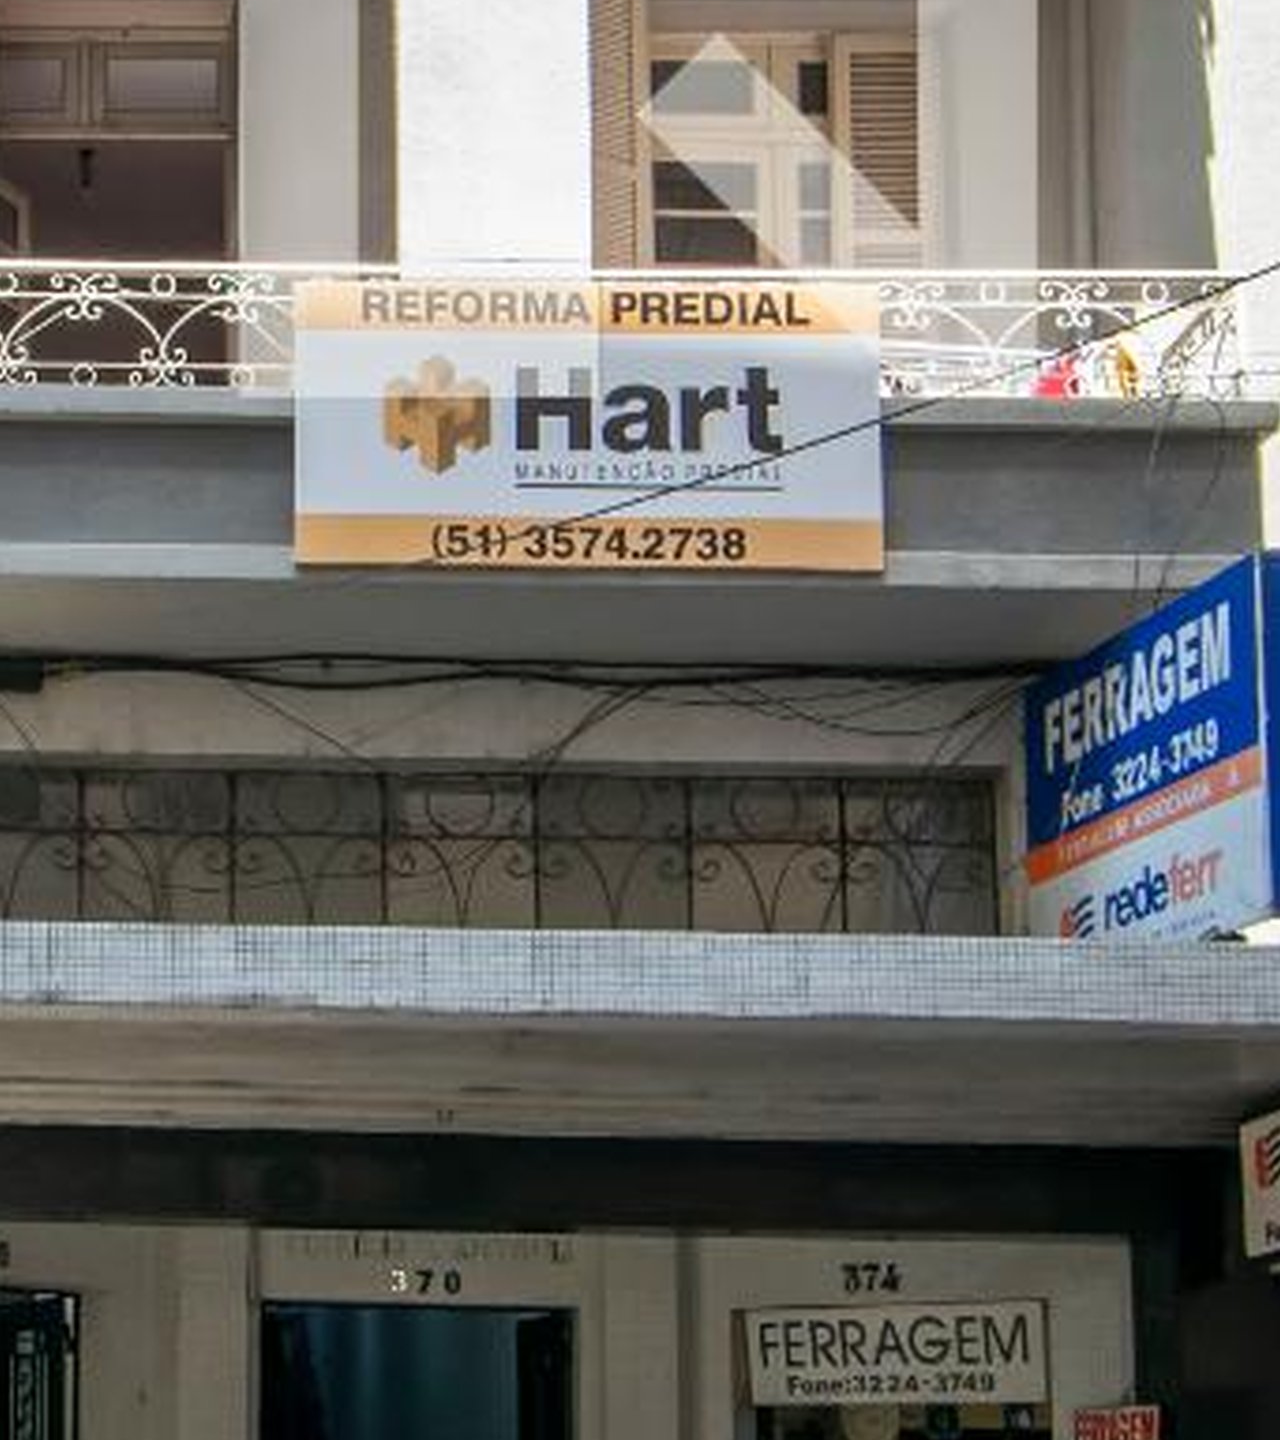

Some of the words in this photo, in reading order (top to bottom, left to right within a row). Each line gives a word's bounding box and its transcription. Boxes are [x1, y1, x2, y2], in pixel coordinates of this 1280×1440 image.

[360, 289, 592, 324] REFORMA
[610, 291, 809, 327] PREDIAL
[514, 366, 783, 454] Hart
[514, 458, 675, 481] MANUTENÇÃO
[431, 522, 508, 560] (51)
[522, 525, 746, 561] 3574.2738
[1042, 600, 1232, 776] FERRAGEM
[1109, 717, 1220, 802] 3224-3749
[1104, 852, 1224, 931] redeferr
[841, 1263, 902, 1293] 374
[758, 1315, 1030, 1369] FERRAGEM
